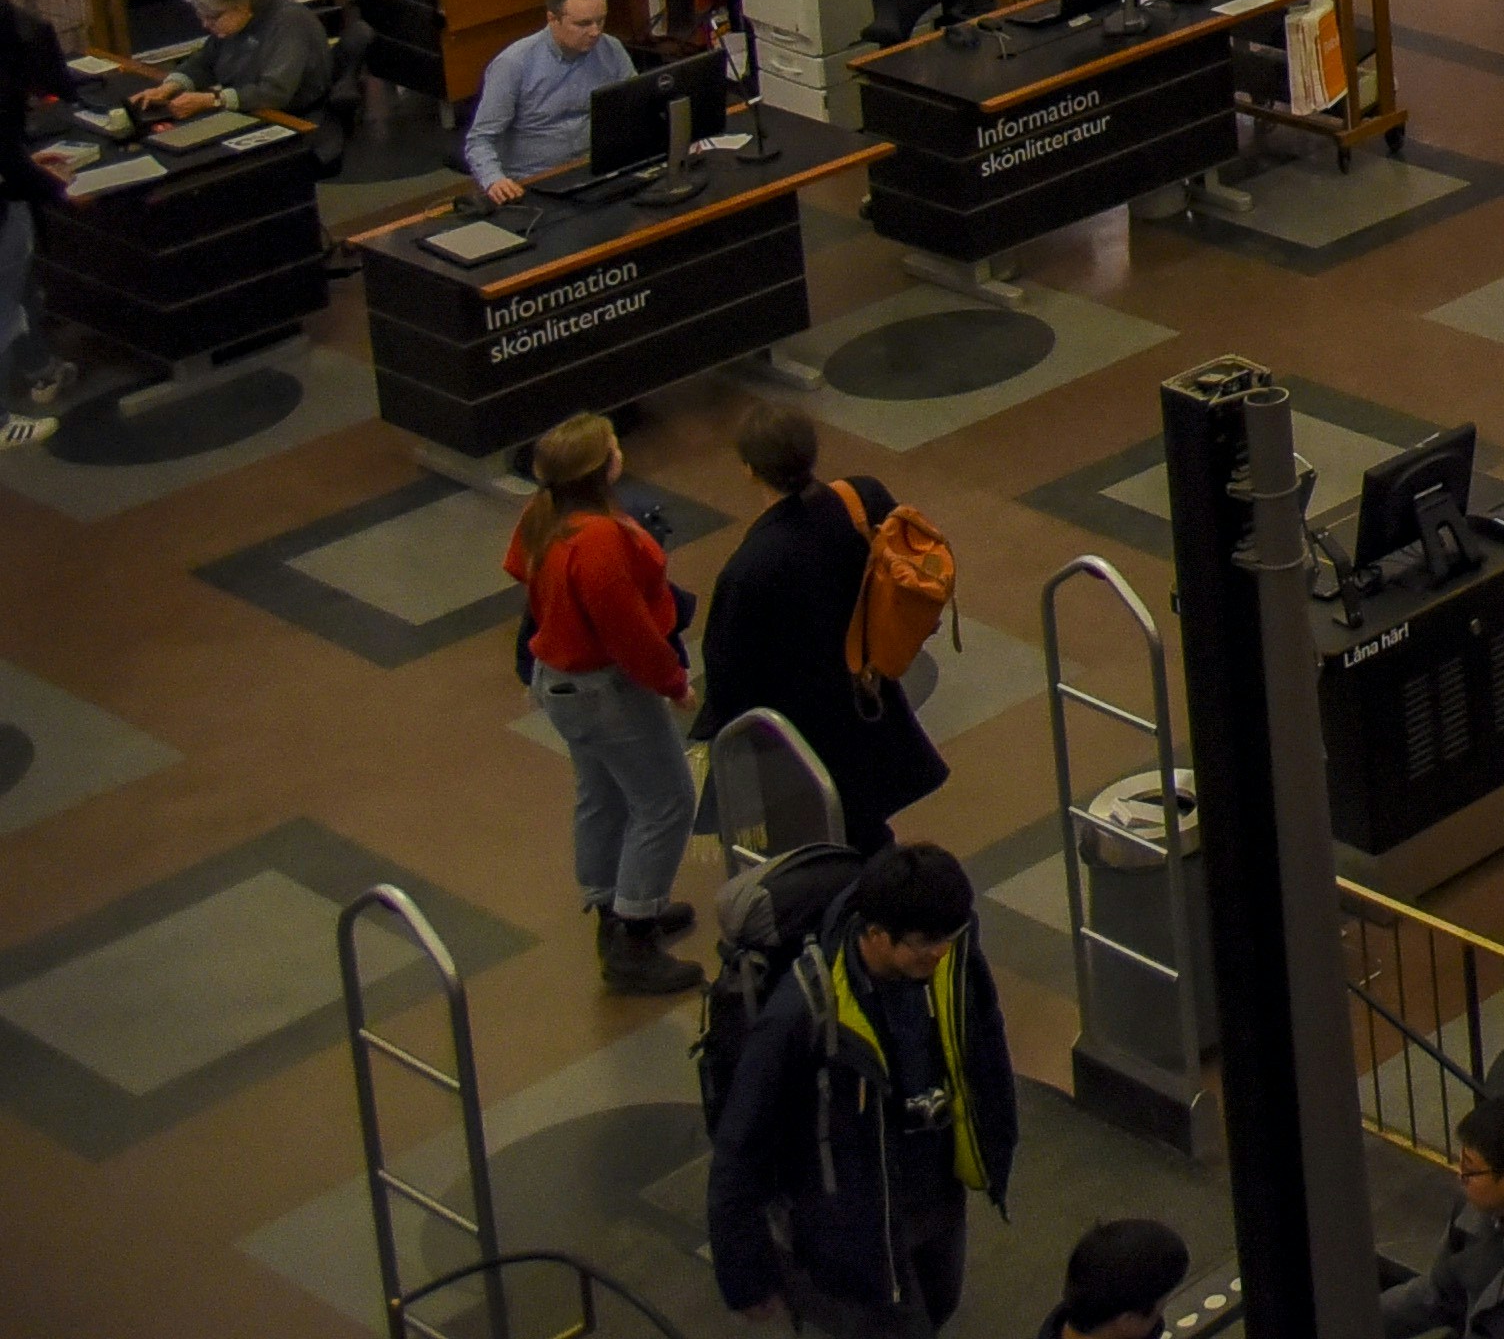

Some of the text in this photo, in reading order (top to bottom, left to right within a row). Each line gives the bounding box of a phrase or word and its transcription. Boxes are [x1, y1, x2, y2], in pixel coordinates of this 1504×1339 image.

[978, 90, 1100, 148] Information
[981, 115, 1111, 177] skönlitteratur
[486, 262, 638, 331] Information
[491, 289, 652, 364] skönlitteratur
[1344, 622, 1409, 668] Låna här!
